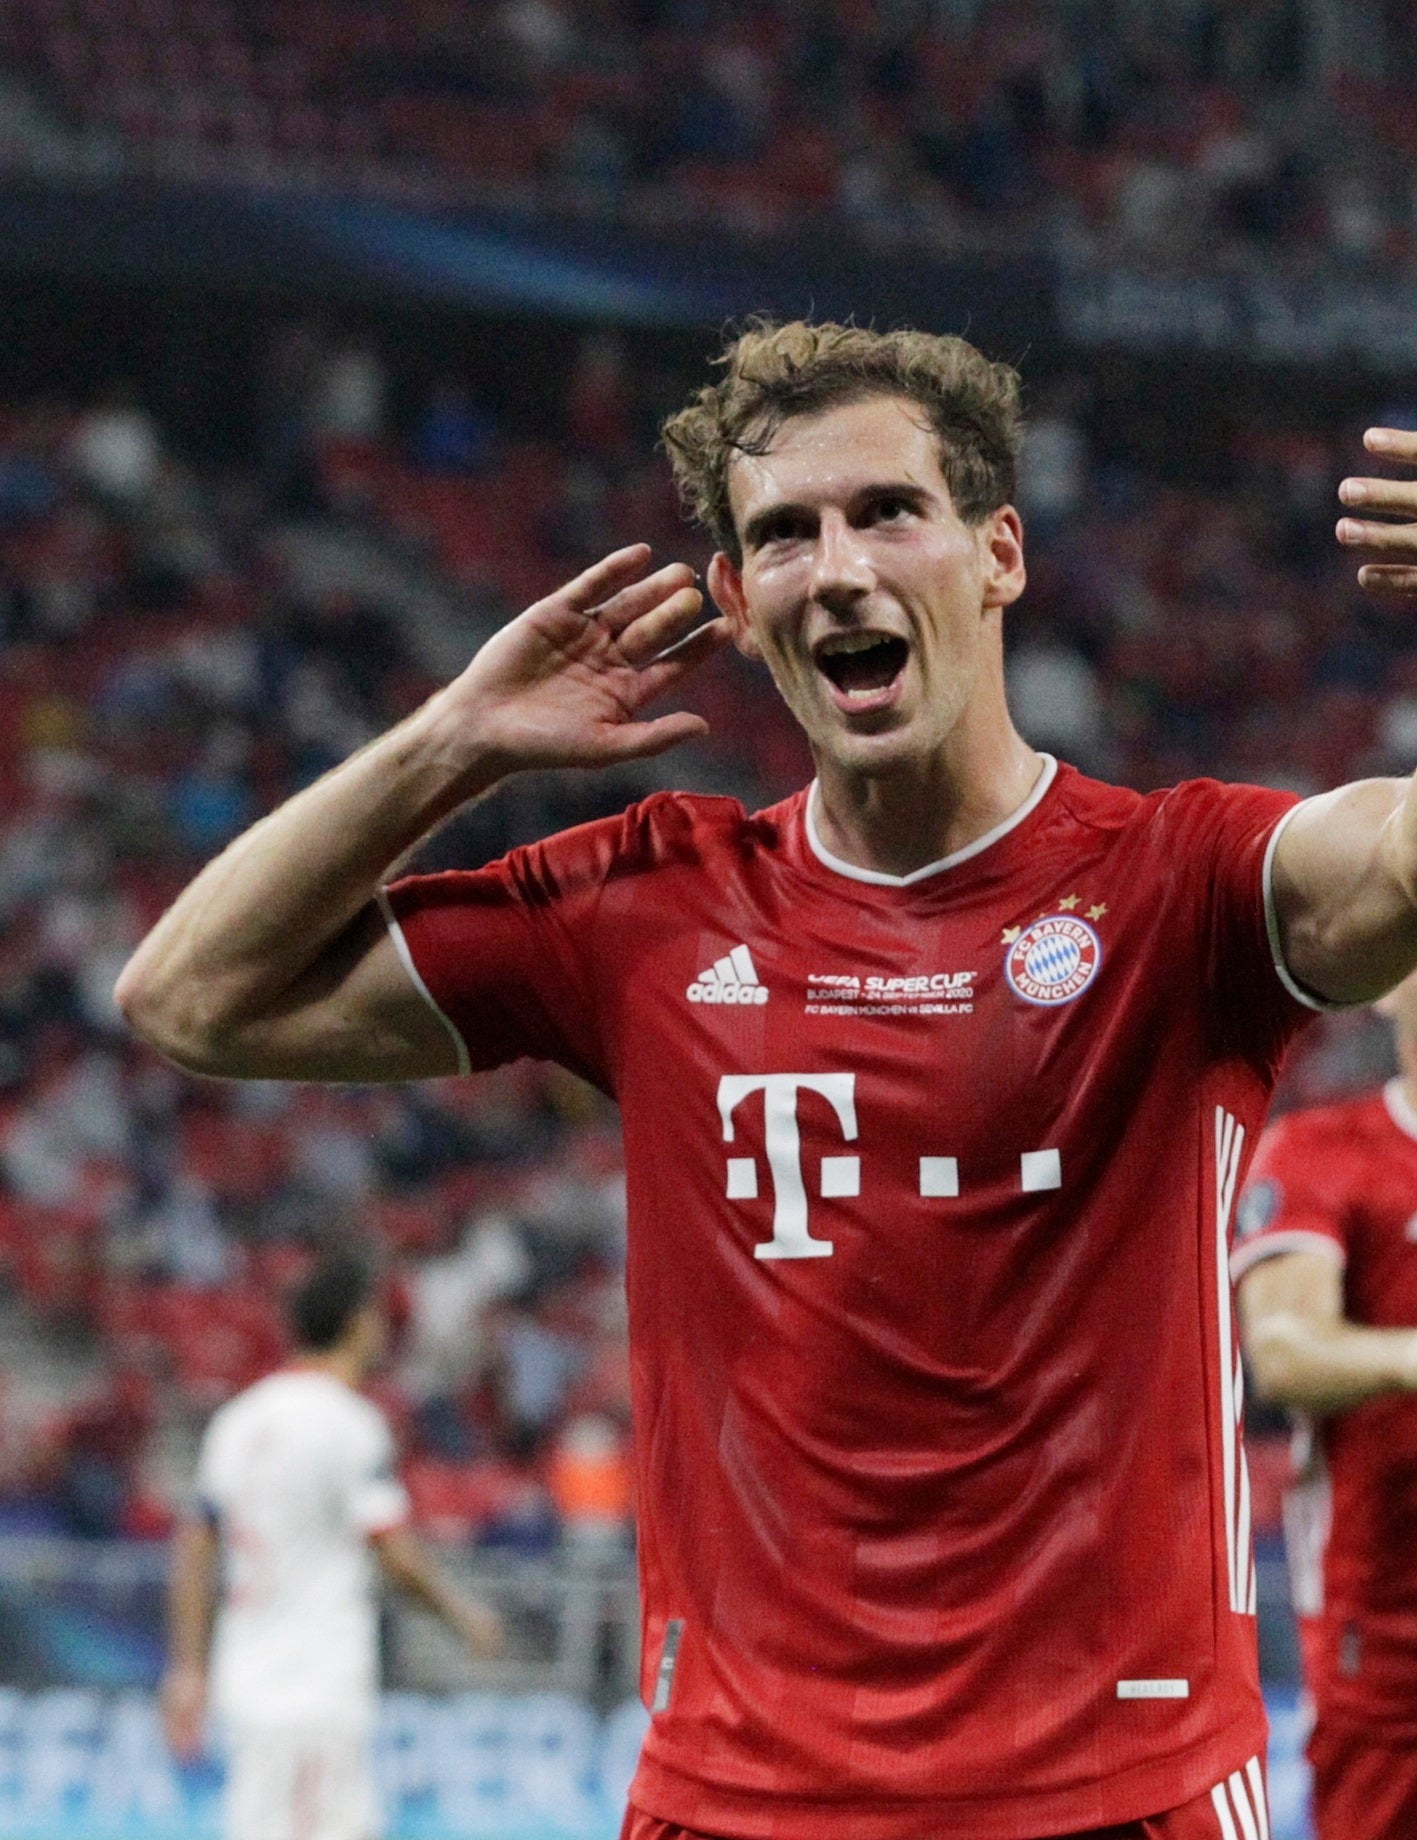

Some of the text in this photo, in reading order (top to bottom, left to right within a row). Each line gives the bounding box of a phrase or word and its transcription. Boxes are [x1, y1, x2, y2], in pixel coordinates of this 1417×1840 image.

[1012, 922, 1092, 960] FC BAYERN
[864, 976, 930, 992] SUPER
[930, 971, 973, 990] CUP
[686, 981, 769, 1005] adidas
[807, 988, 860, 1000] BUDAPEST
[805, 1004, 820, 1014] FC
[820, 1005, 858, 1015] BAYERN
[959, 1003, 974, 1013] FC
